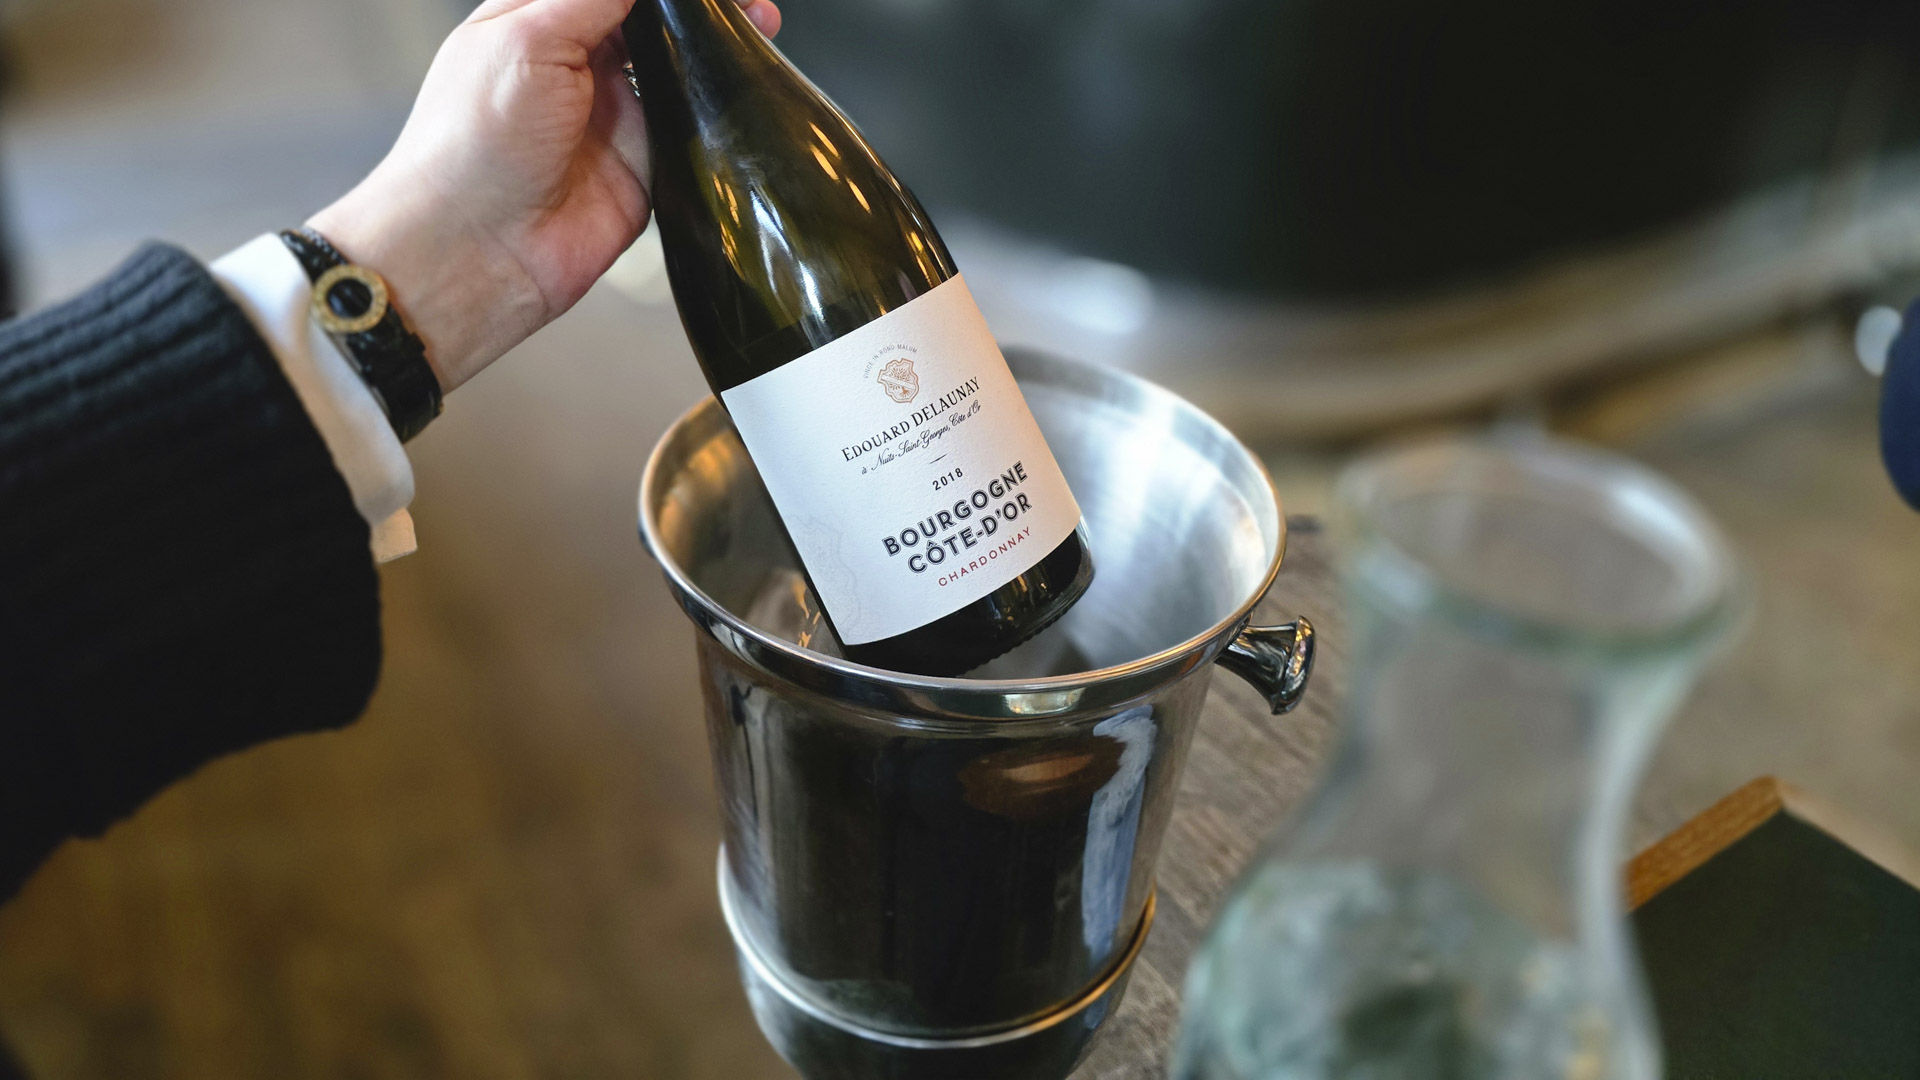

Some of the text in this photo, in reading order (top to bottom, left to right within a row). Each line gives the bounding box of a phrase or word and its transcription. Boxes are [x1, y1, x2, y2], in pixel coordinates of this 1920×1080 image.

[873, 354, 880, 362] IN
[897, 344, 918, 354] MALUM
[841, 376, 981, 461] EDOUARD DELAUNAY
[881, 460, 1029, 557] BOURGOGNE
[932, 467, 964, 491] 2018
[907, 492, 1033, 574] CÔTE-D'OR
[938, 526, 1032, 587] CHARDONNAY
